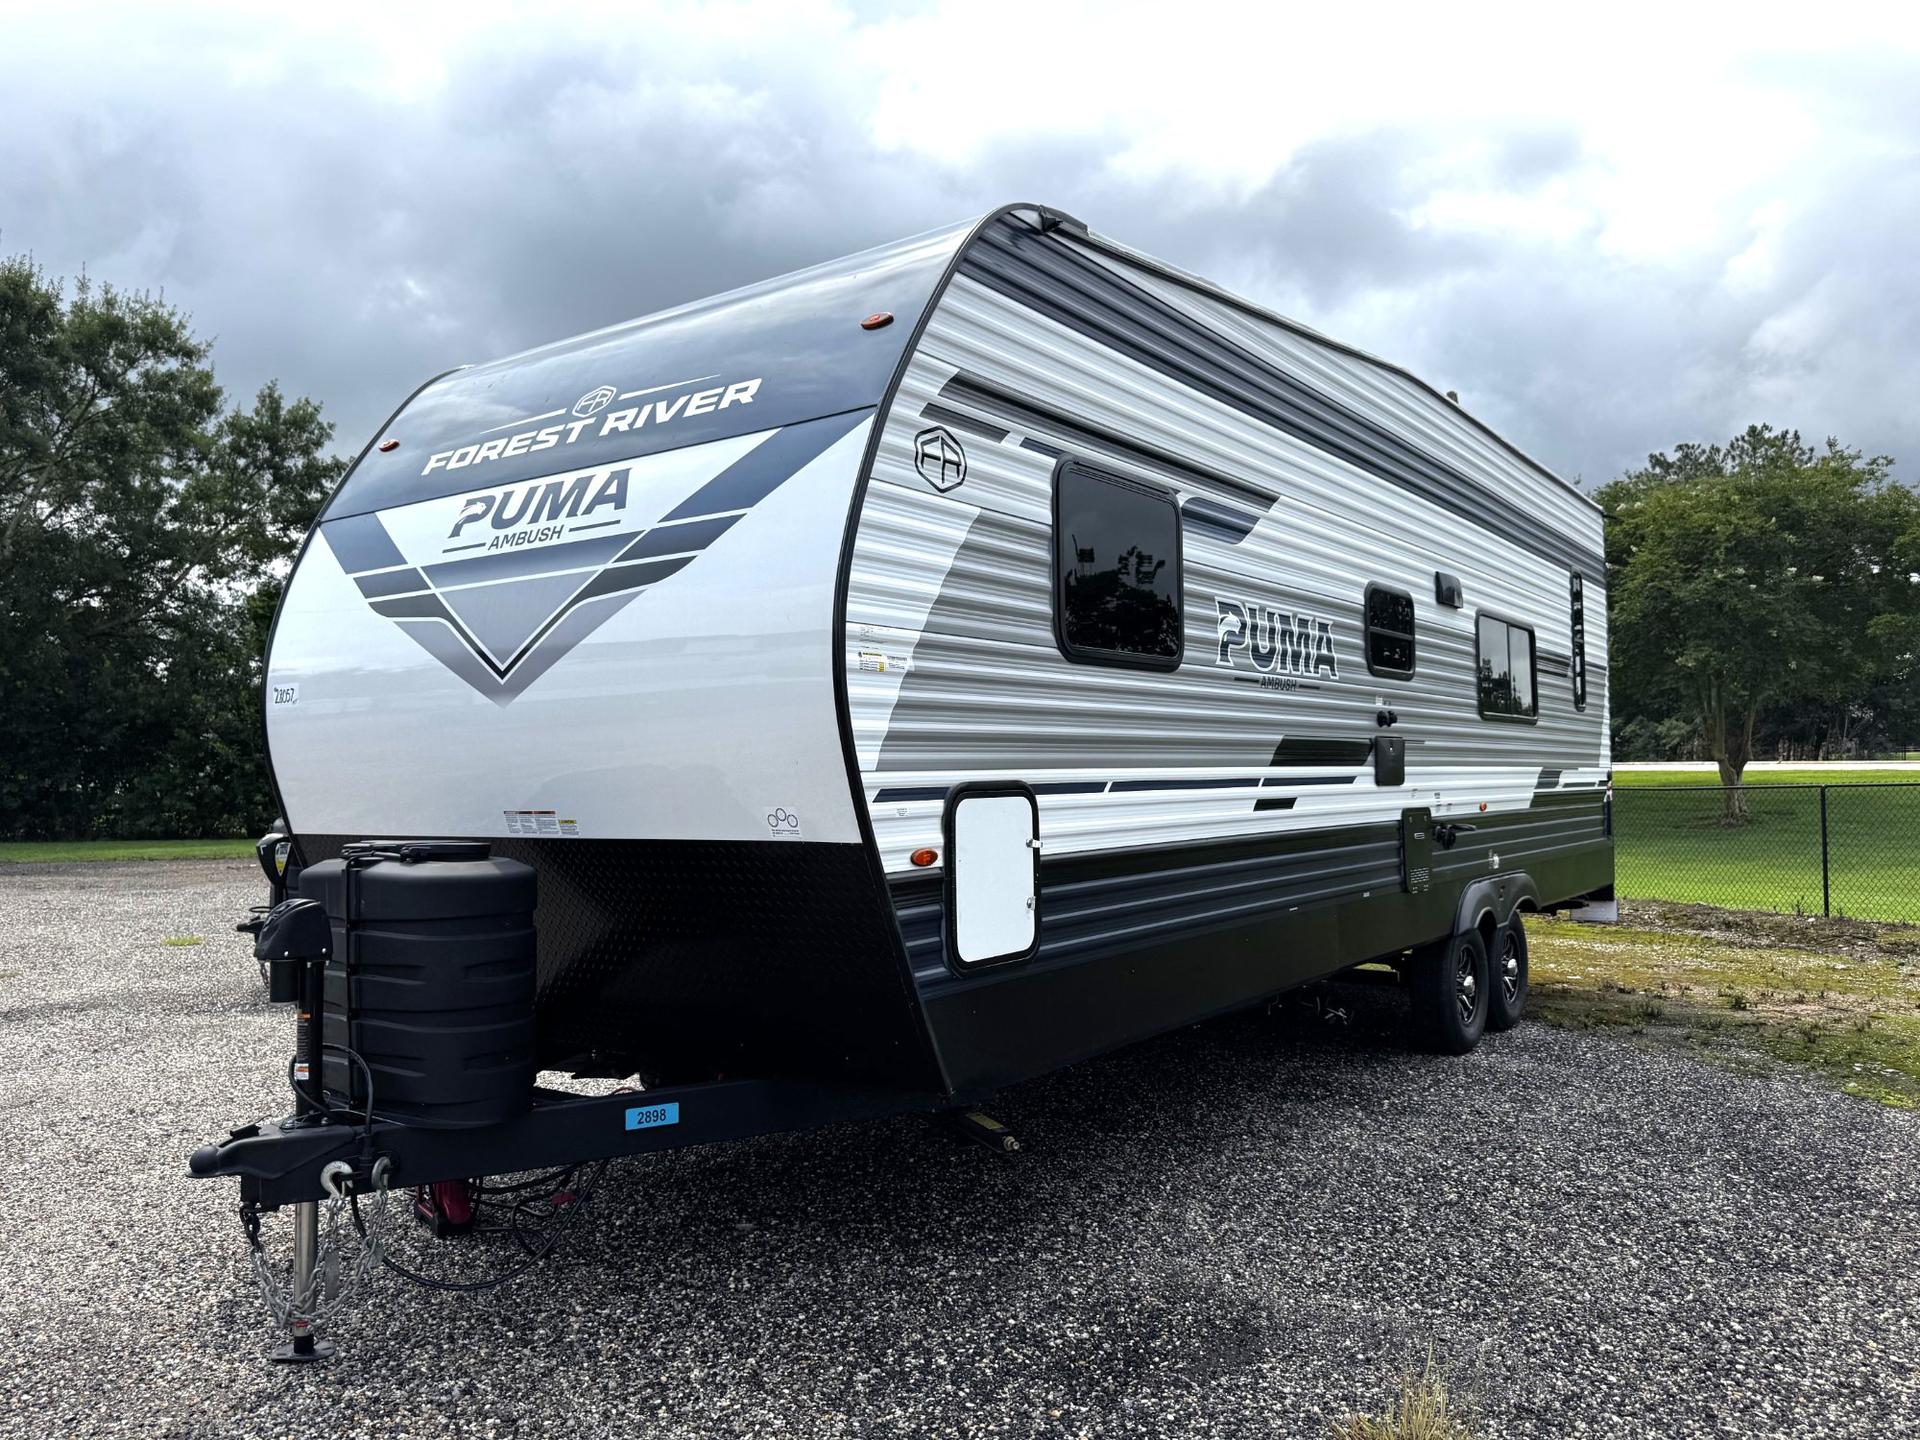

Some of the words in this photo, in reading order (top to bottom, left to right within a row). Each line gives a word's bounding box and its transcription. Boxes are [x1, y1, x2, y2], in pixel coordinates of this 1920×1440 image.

[421, 418, 597, 475] FOREST
[599, 378, 762, 436] RIVER
[448, 467, 632, 539] PUMA
[488, 525, 564, 551] AMBUSH
[1216, 597, 1339, 679] PUMA
[1261, 675, 1297, 692] AMBUSH
[637, 1108, 667, 1125] 2898
